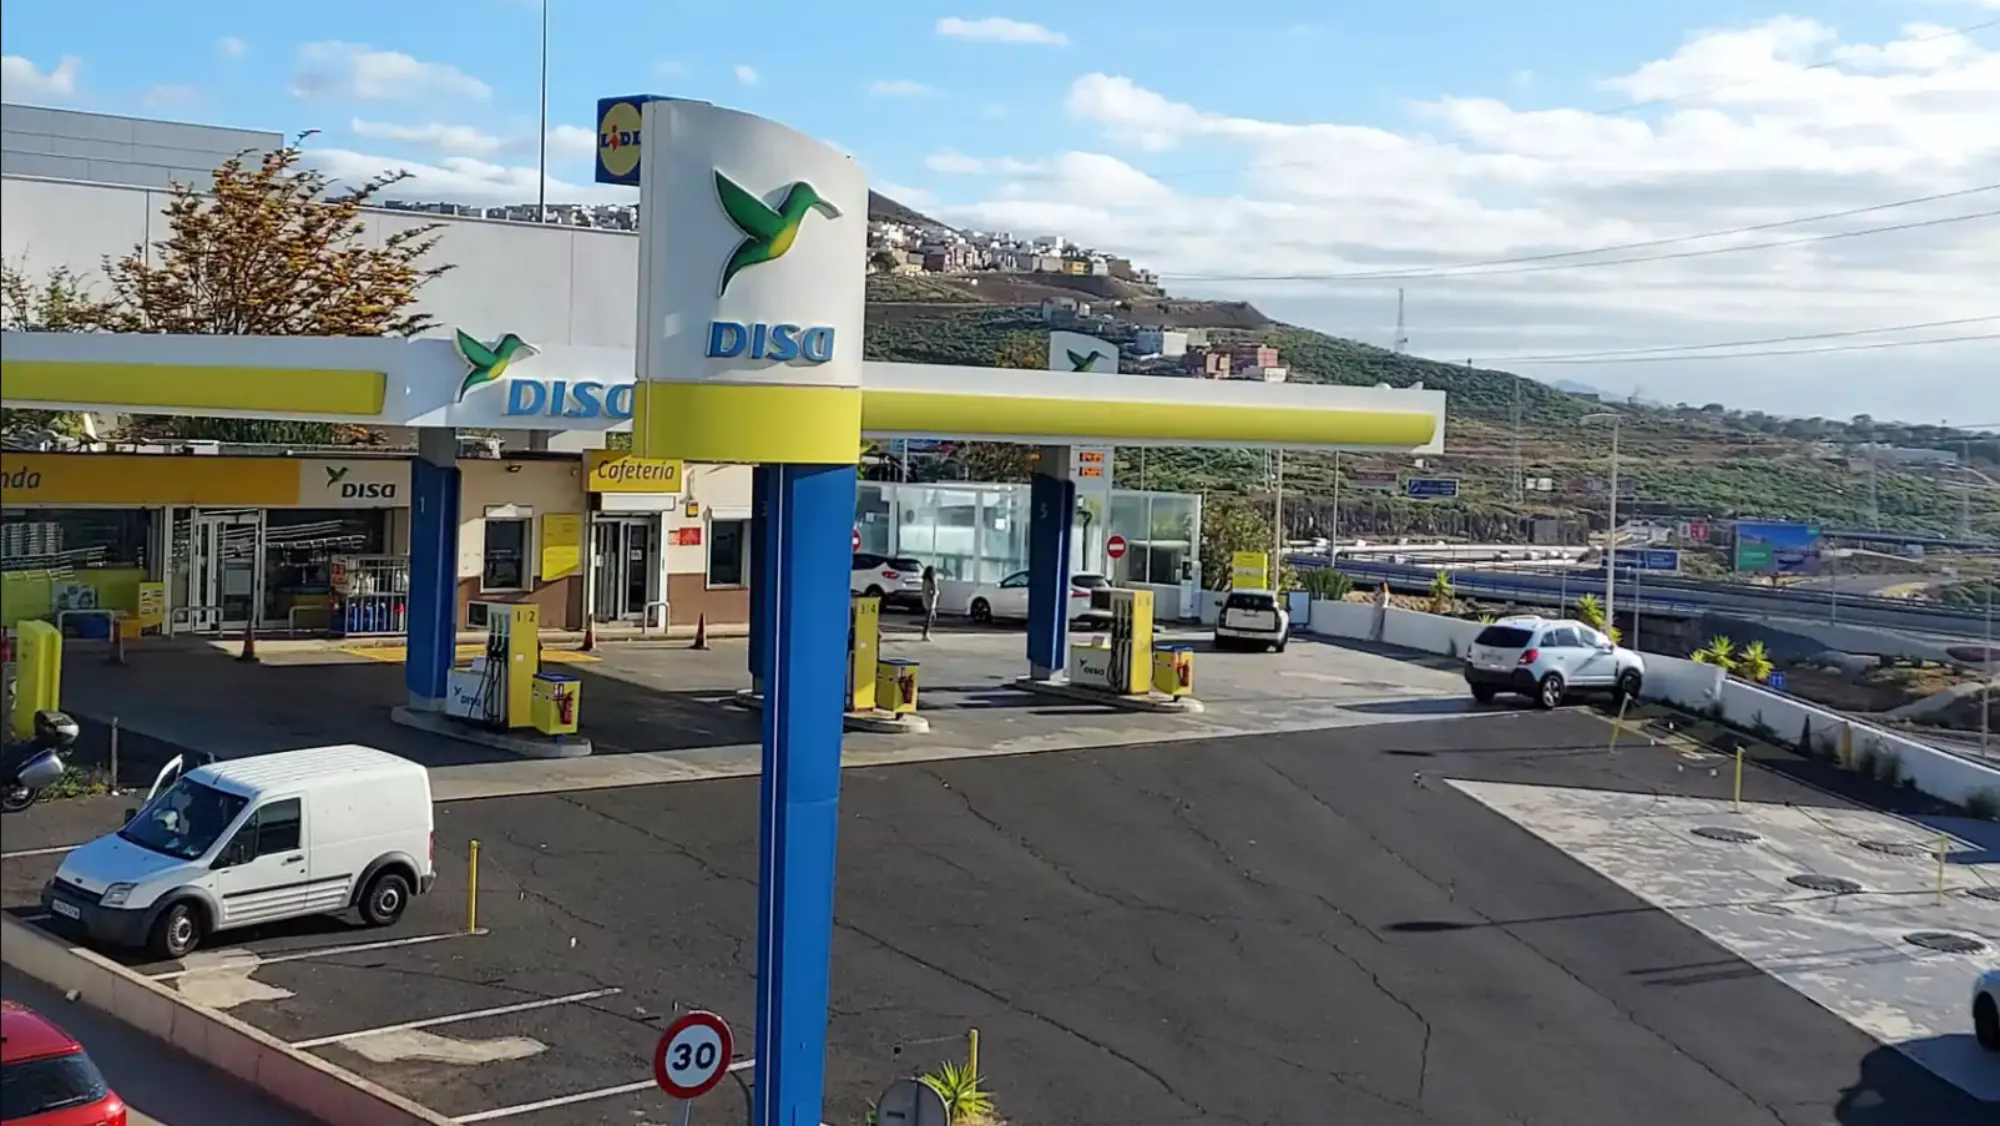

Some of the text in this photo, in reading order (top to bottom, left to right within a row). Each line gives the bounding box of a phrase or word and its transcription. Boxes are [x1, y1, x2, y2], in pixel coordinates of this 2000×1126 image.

[420, 496, 425, 513] 1
[529, 610, 535, 622] 2
[672, 1041, 716, 1071] 30
